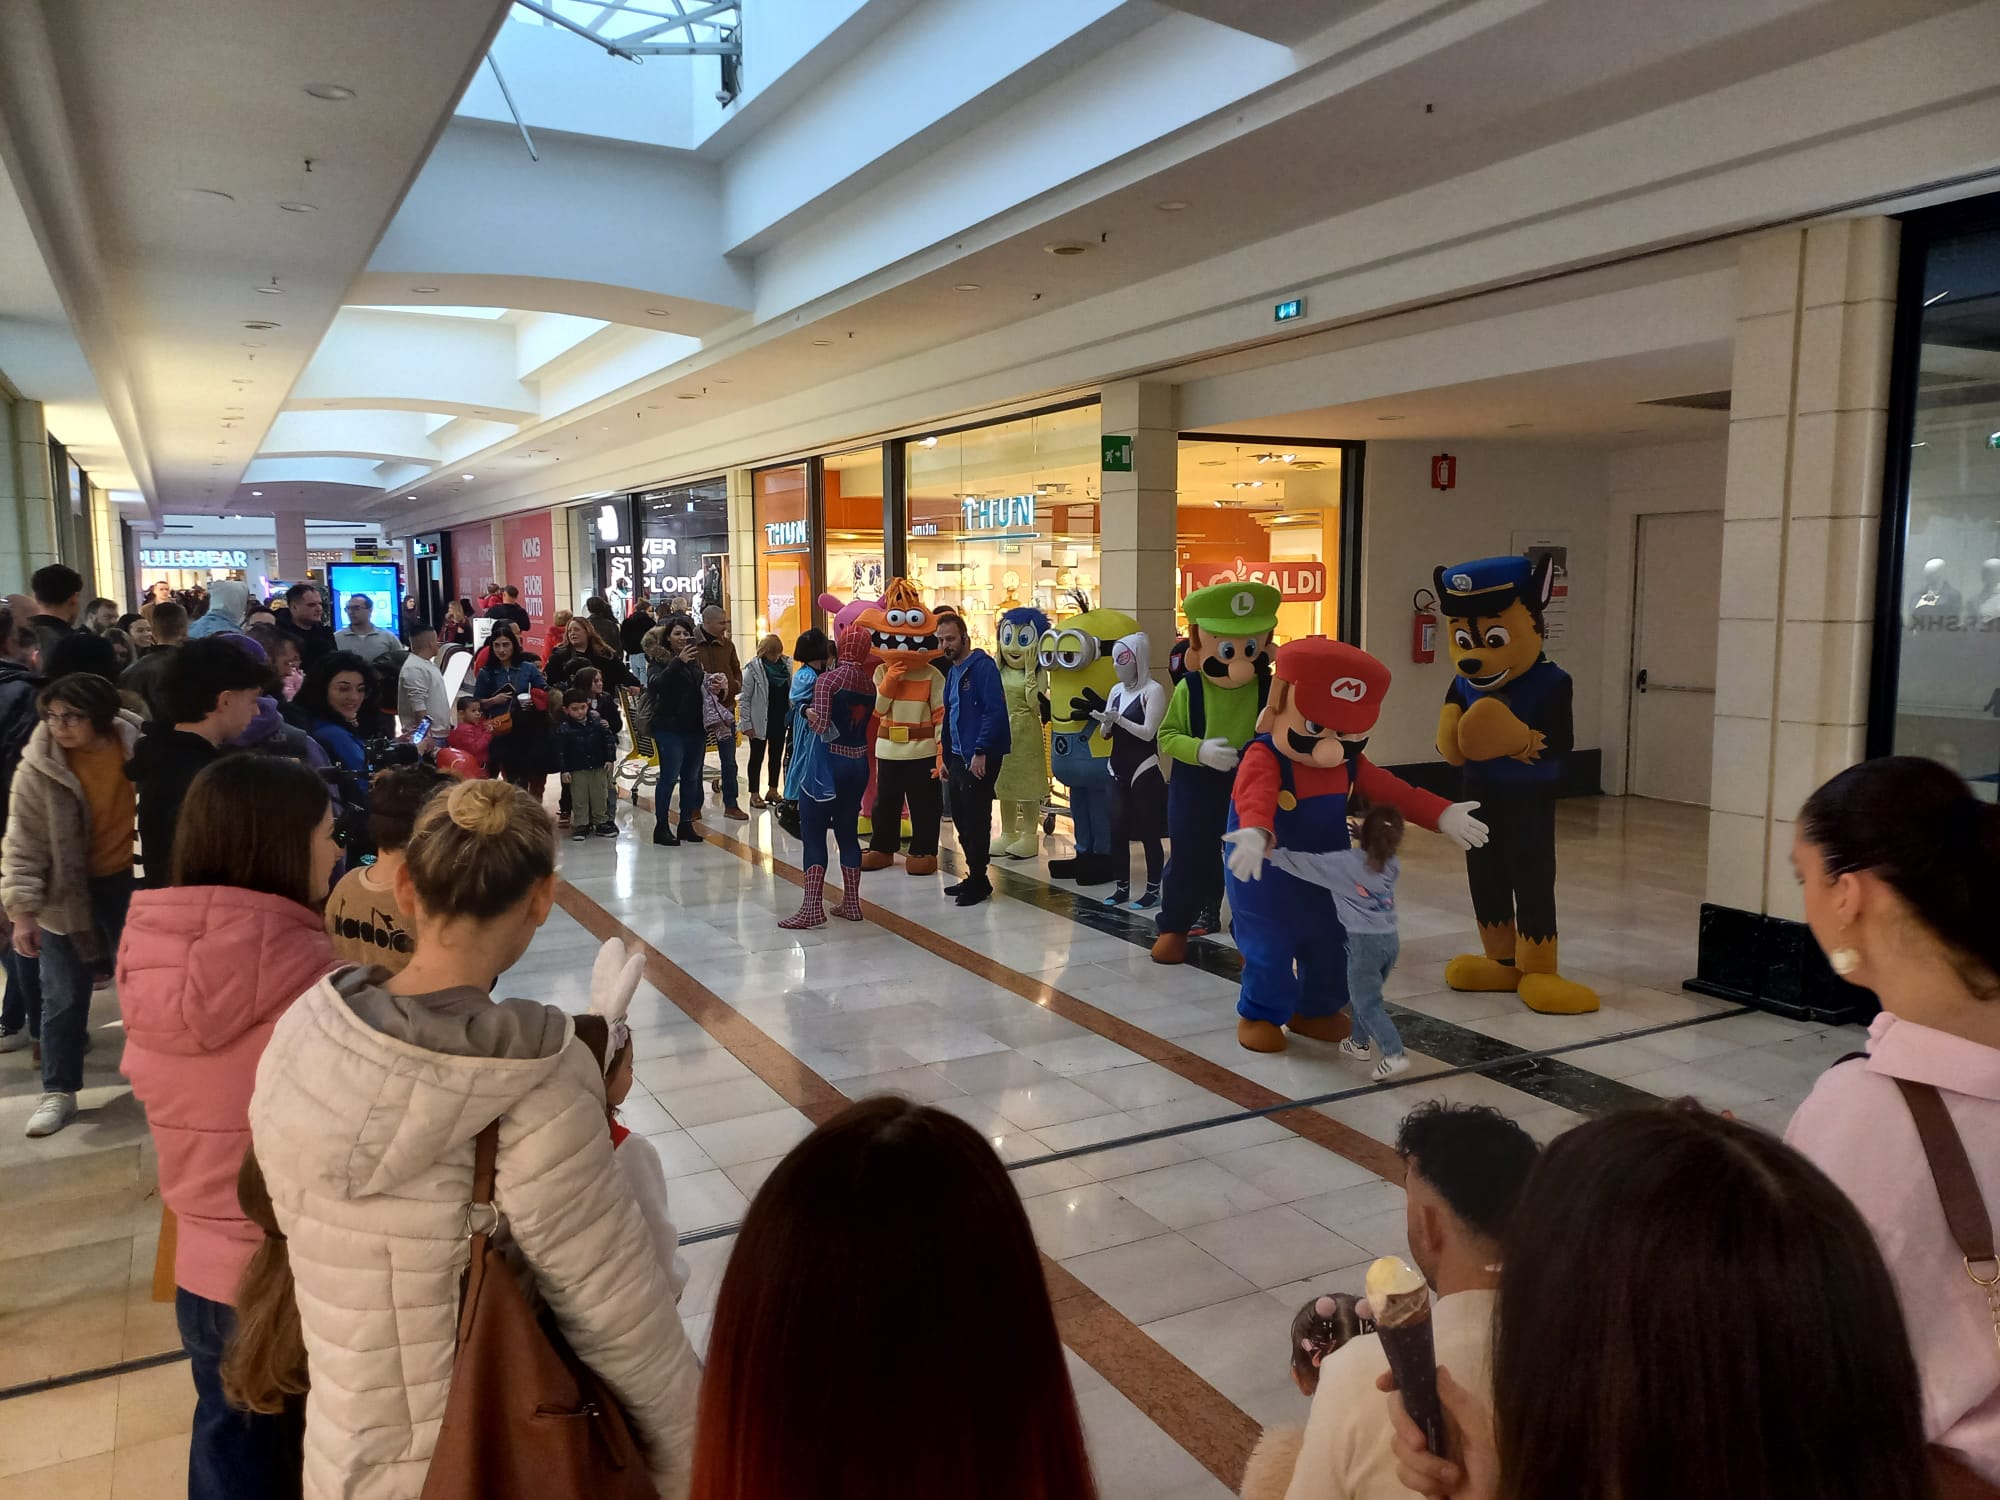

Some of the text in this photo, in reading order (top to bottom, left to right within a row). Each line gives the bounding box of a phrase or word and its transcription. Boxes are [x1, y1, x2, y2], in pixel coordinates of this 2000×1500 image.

[961, 494, 1035, 531] THUN
[765, 519, 807, 546] THUN
[522, 537, 541, 558] KING
[140, 550, 248, 568] ULL&BEAR
[524, 575, 543, 596] FUORI
[525, 597, 544, 617] TUTTO
